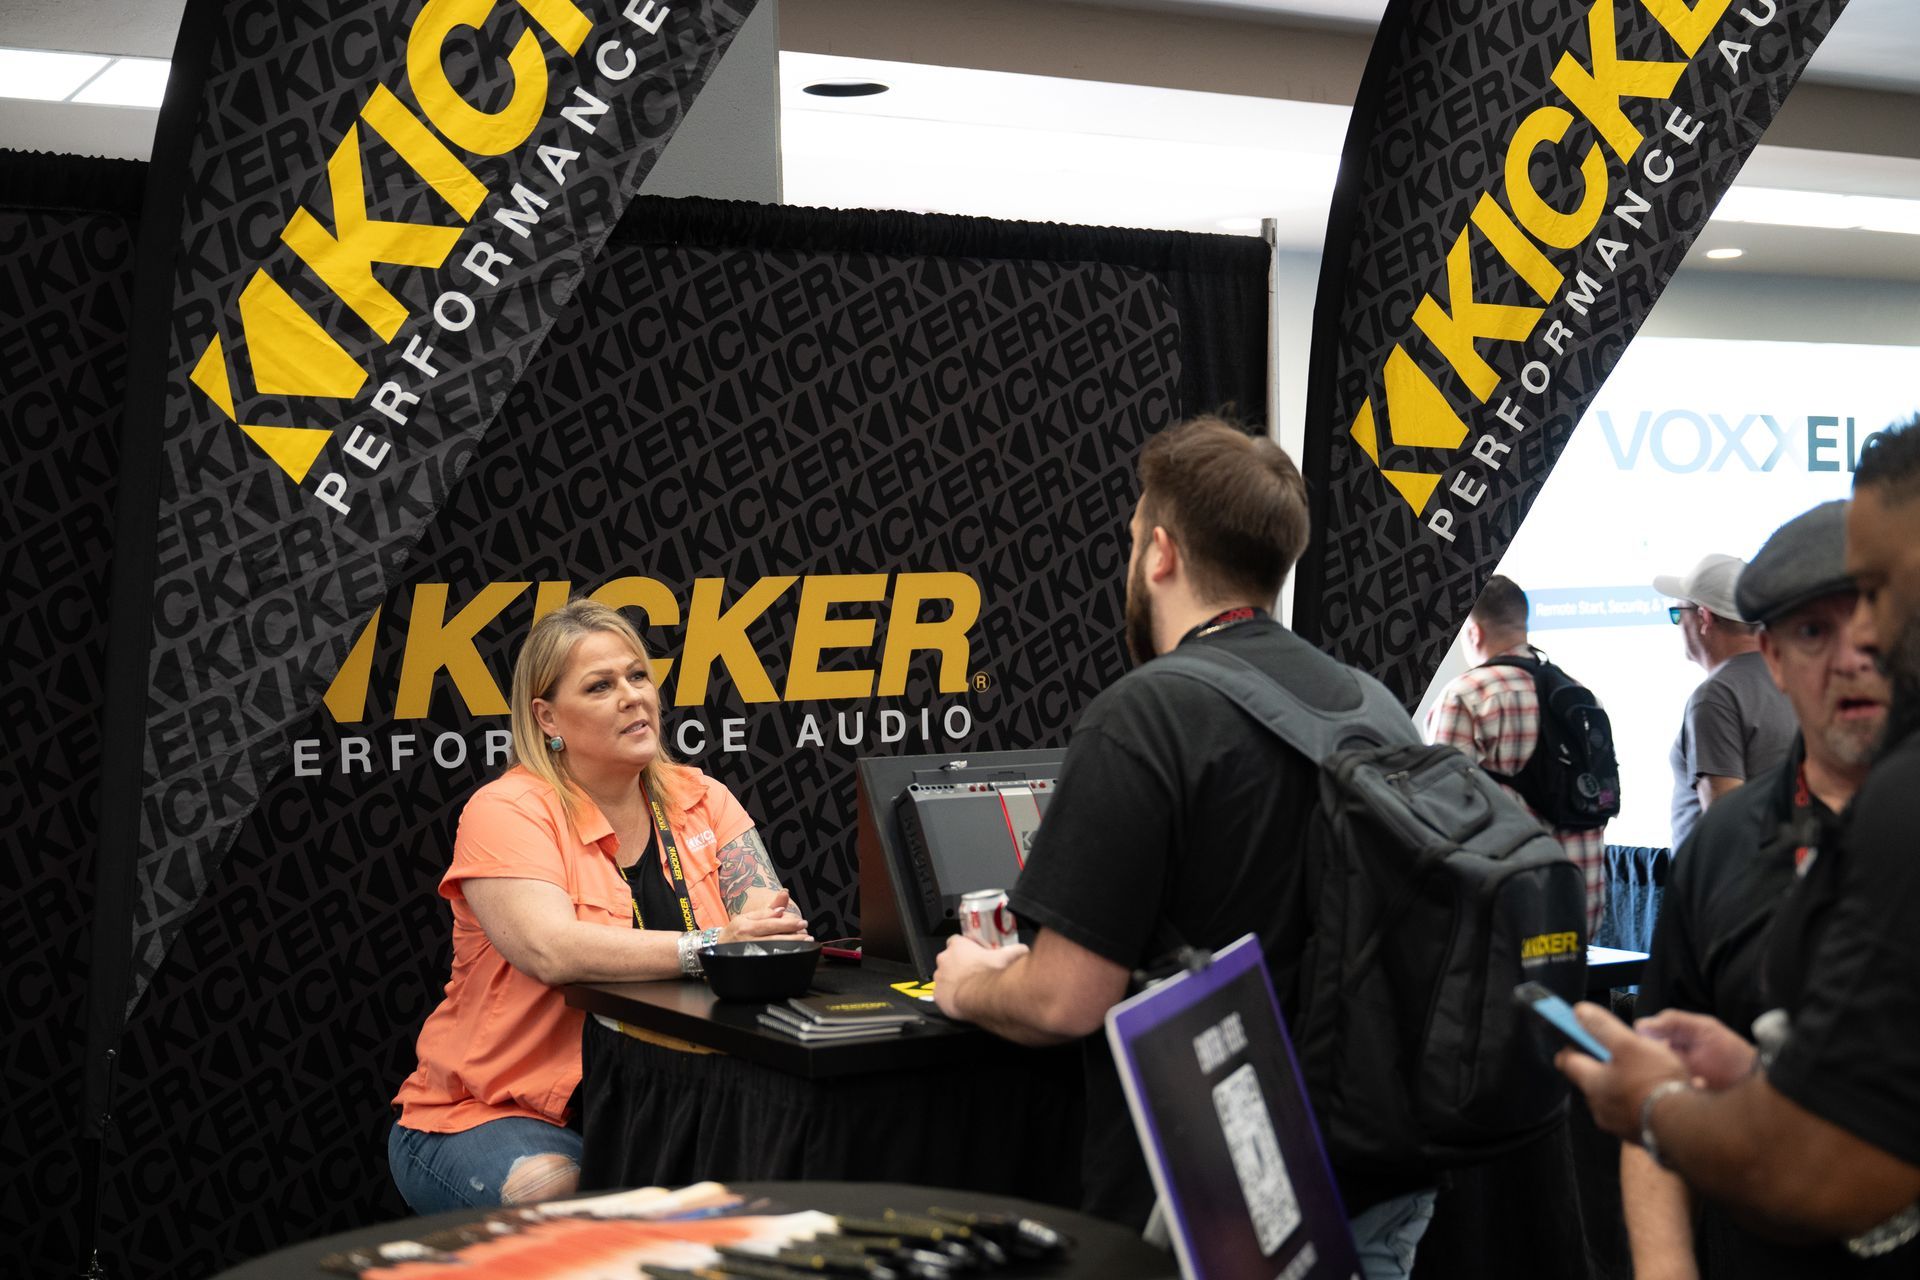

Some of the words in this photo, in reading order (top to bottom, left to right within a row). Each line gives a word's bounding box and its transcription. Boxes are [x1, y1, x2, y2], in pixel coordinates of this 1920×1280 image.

[314, 0, 670, 515] PERFORMANCE
[575, 245, 765, 392] KICKER
[1428, 106, 1704, 542] PERFORMANCE
[428, 391, 629, 547] KICKER
[657, 259, 841, 404] KICKER
[515, 403, 709, 556] KICKER
[736, 272, 914, 415] KICKER
[599, 414, 786, 566] KICKER
[813, 285, 986, 427] KICKER
[680, 425, 861, 575] KICKER
[887, 298, 1055, 438] KICKER
[758, 436, 934, 583] KICKER
[959, 310, 1122, 448] KICKER
[1029, 322, 1183, 458] KICKER
[978, 467, 1139, 608] KICKER
[1536, 603, 1577, 617] Remote
[797, 705, 972, 748] AUDIO
[668, 850, 683, 881] KICKER
[139, 888, 360, 1067] KICKER
[235, 892, 449, 1068] KICKER
[168, 1065, 386, 1249] KICKER
